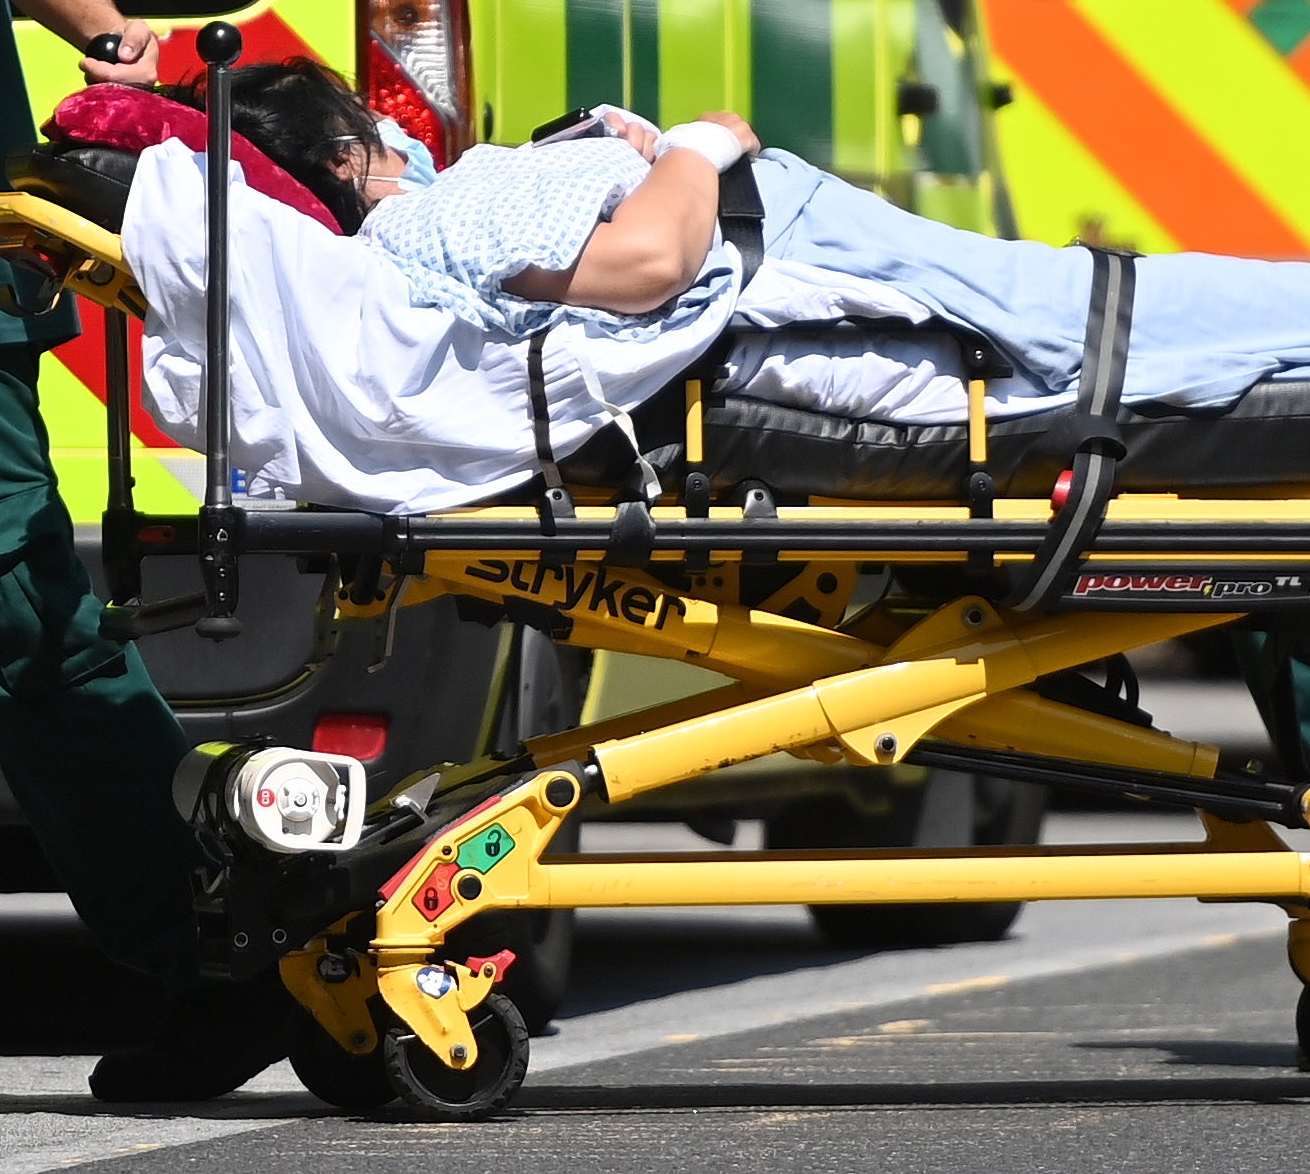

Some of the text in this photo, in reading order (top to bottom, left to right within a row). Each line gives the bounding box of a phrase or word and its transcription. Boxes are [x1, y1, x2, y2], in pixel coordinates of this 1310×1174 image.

[1073, 574, 1302, 599] power pro TL
